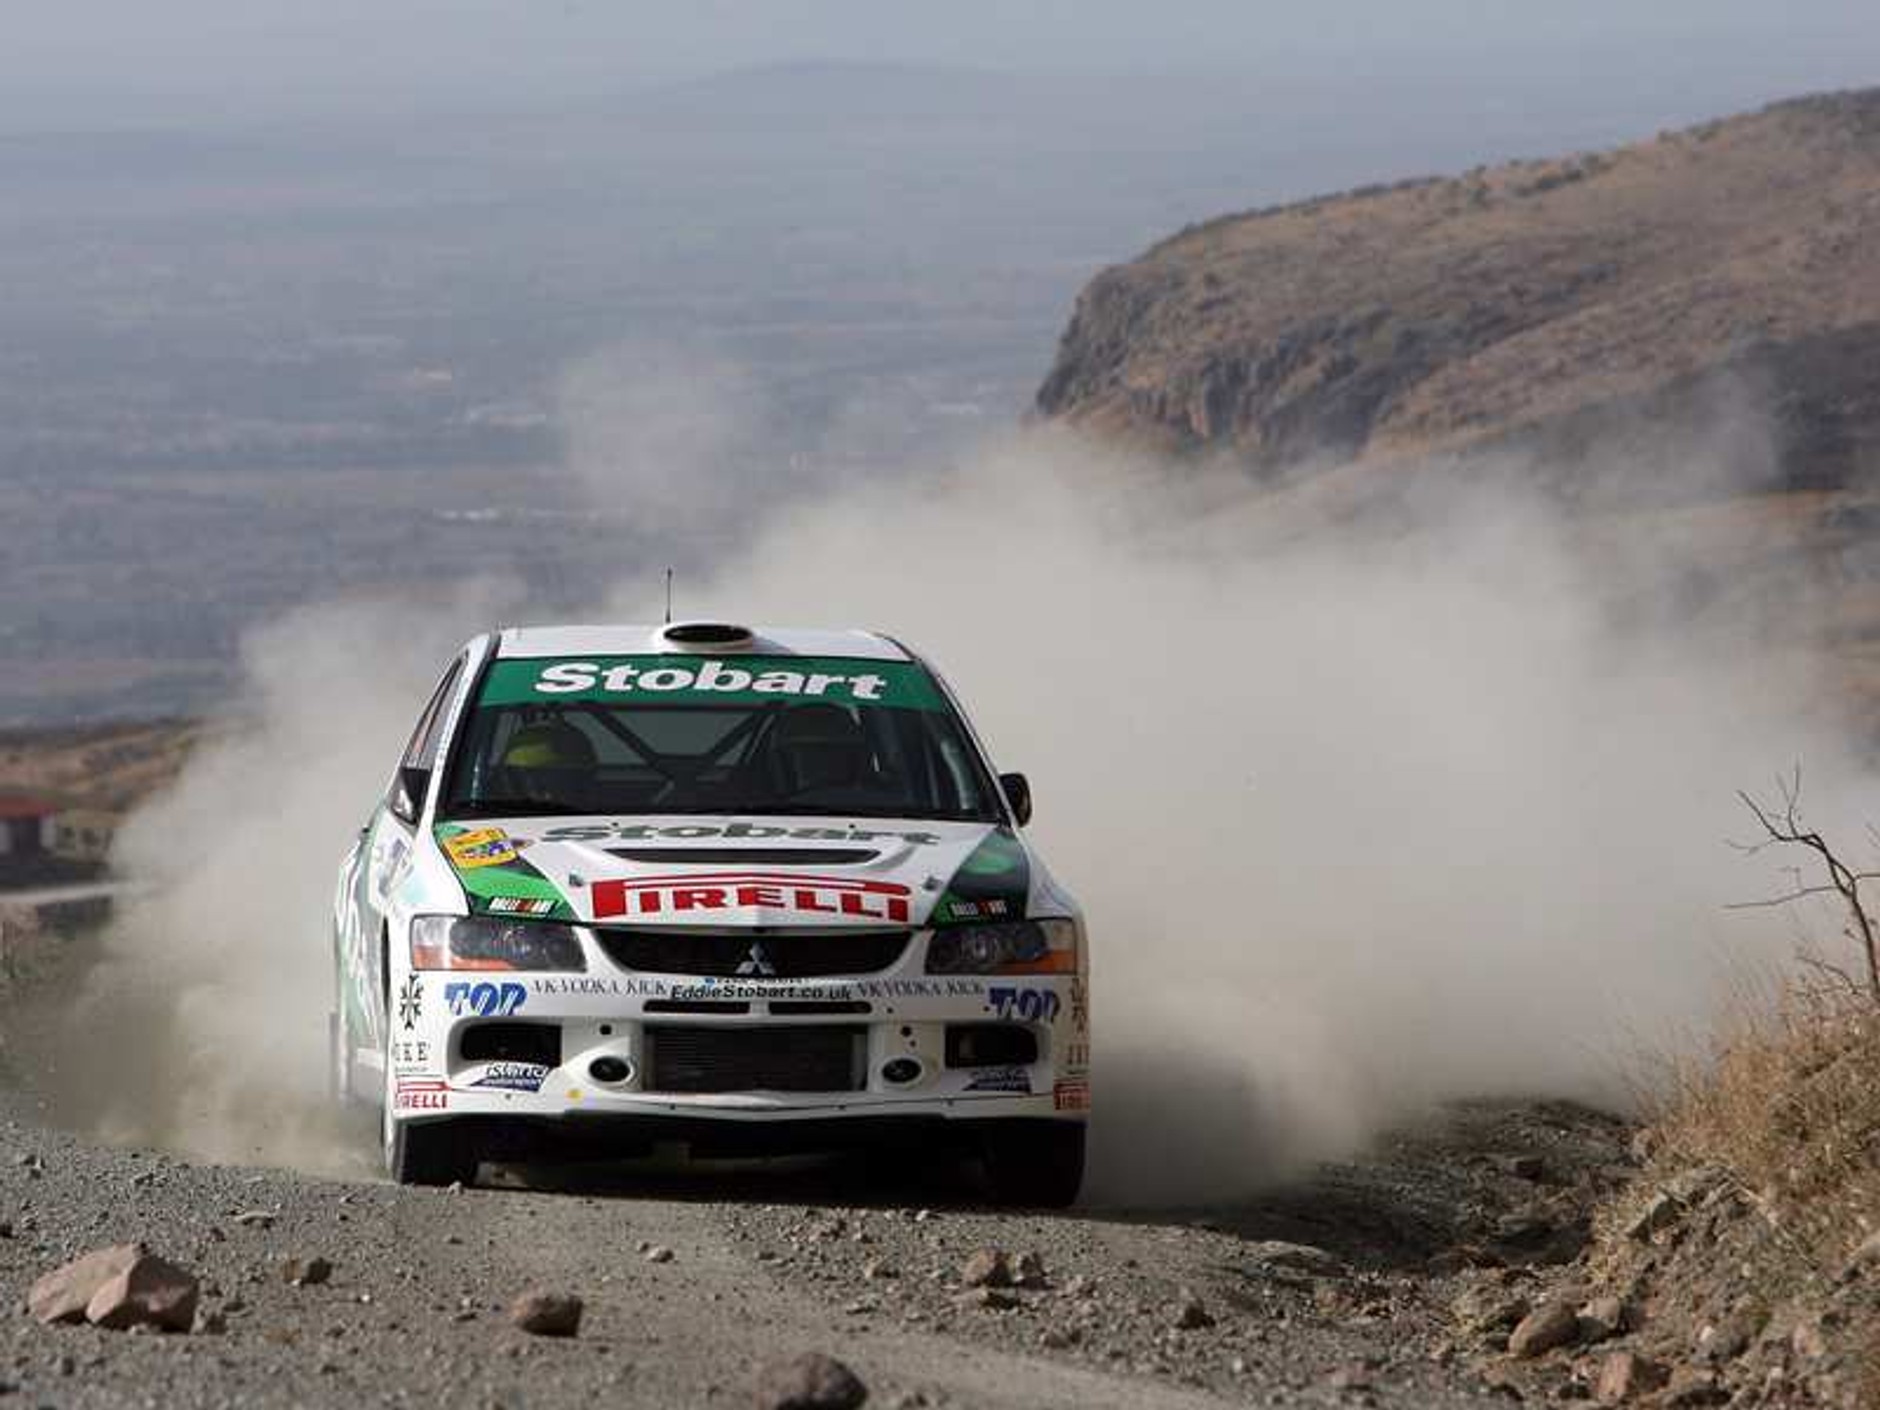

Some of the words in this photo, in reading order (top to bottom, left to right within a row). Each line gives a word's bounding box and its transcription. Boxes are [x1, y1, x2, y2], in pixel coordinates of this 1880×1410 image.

[535, 662, 887, 699] Stobart
[541, 822, 942, 846] Stobart
[590, 872, 911, 922] PIRELLI
[444, 981, 528, 1017] TOP
